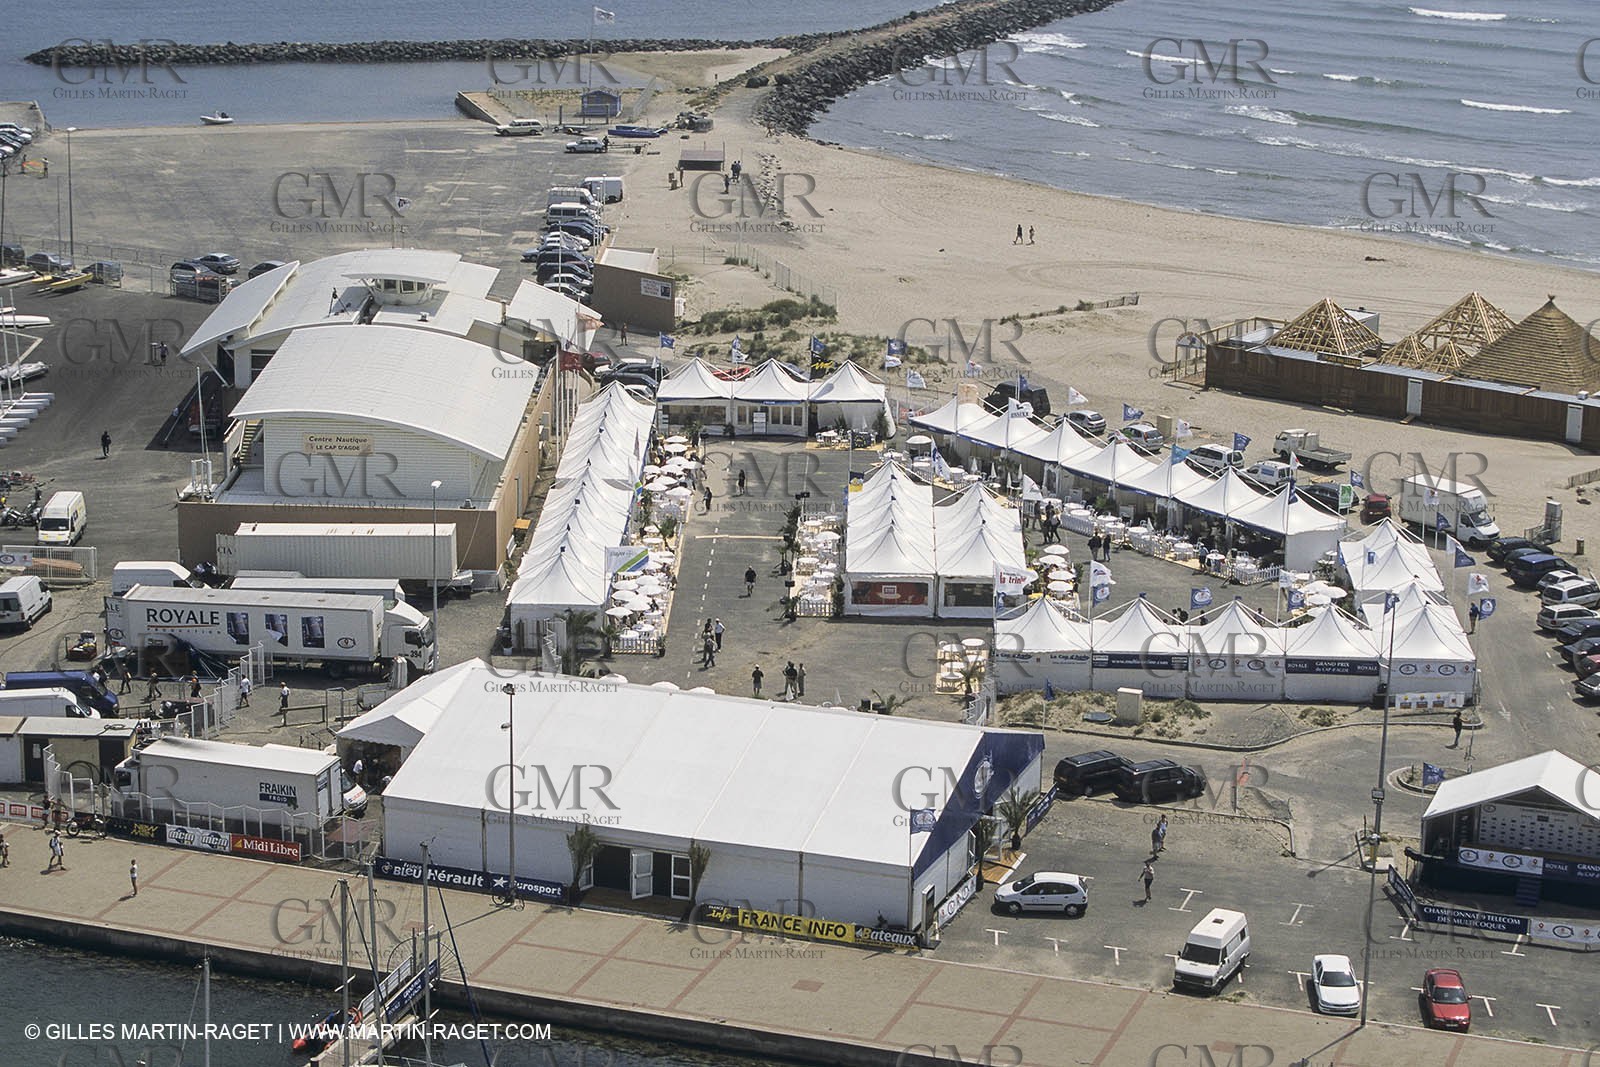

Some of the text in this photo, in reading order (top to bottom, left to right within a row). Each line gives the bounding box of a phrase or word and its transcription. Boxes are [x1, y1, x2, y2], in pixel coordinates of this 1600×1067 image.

[336, 436, 368, 444] Nautique
[146, 608, 220, 625] ROYALE
[259, 782, 296, 796] FRAIKIN
[242, 838, 298, 857] Midi Libre
[427, 868, 484, 887] Hérault
[712, 908, 732, 922] info
[741, 910, 846, 938] FRANCE INFO
[862, 927, 916, 946] Bateaux
